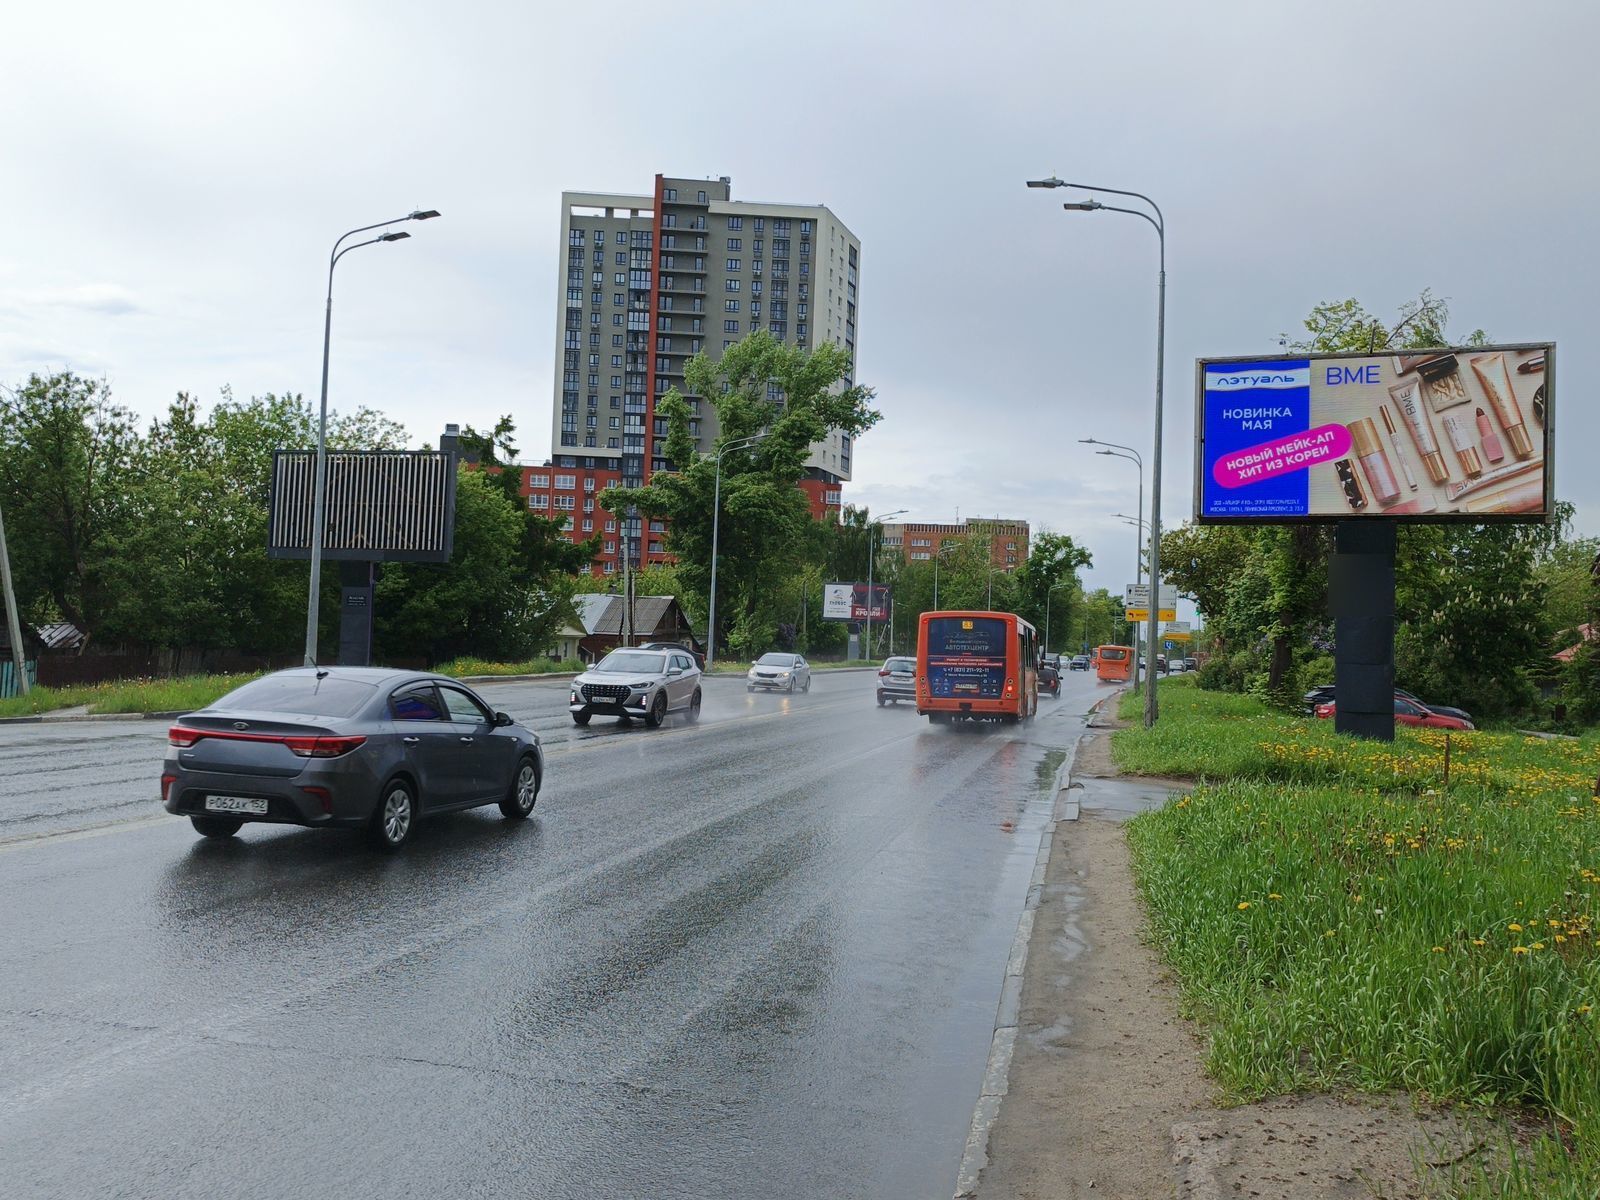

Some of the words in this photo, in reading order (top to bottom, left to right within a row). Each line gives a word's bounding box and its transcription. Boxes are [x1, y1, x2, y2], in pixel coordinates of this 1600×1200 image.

[1326, 365, 1381, 386] BME
[1223, 407, 1293, 420] НОВИНКА
[1242, 419, 1273, 431] МАЯ
[1226, 447, 1274, 471] НОВЫЙ
[1276, 431, 1335, 456] МЕЙК-АП
[1238, 464, 1263, 480] ХИТ
[1266, 458, 1284, 472] ИЗ
[1285, 445, 1330, 466] КОРЕИ
[250, 799, 265, 809] 152
